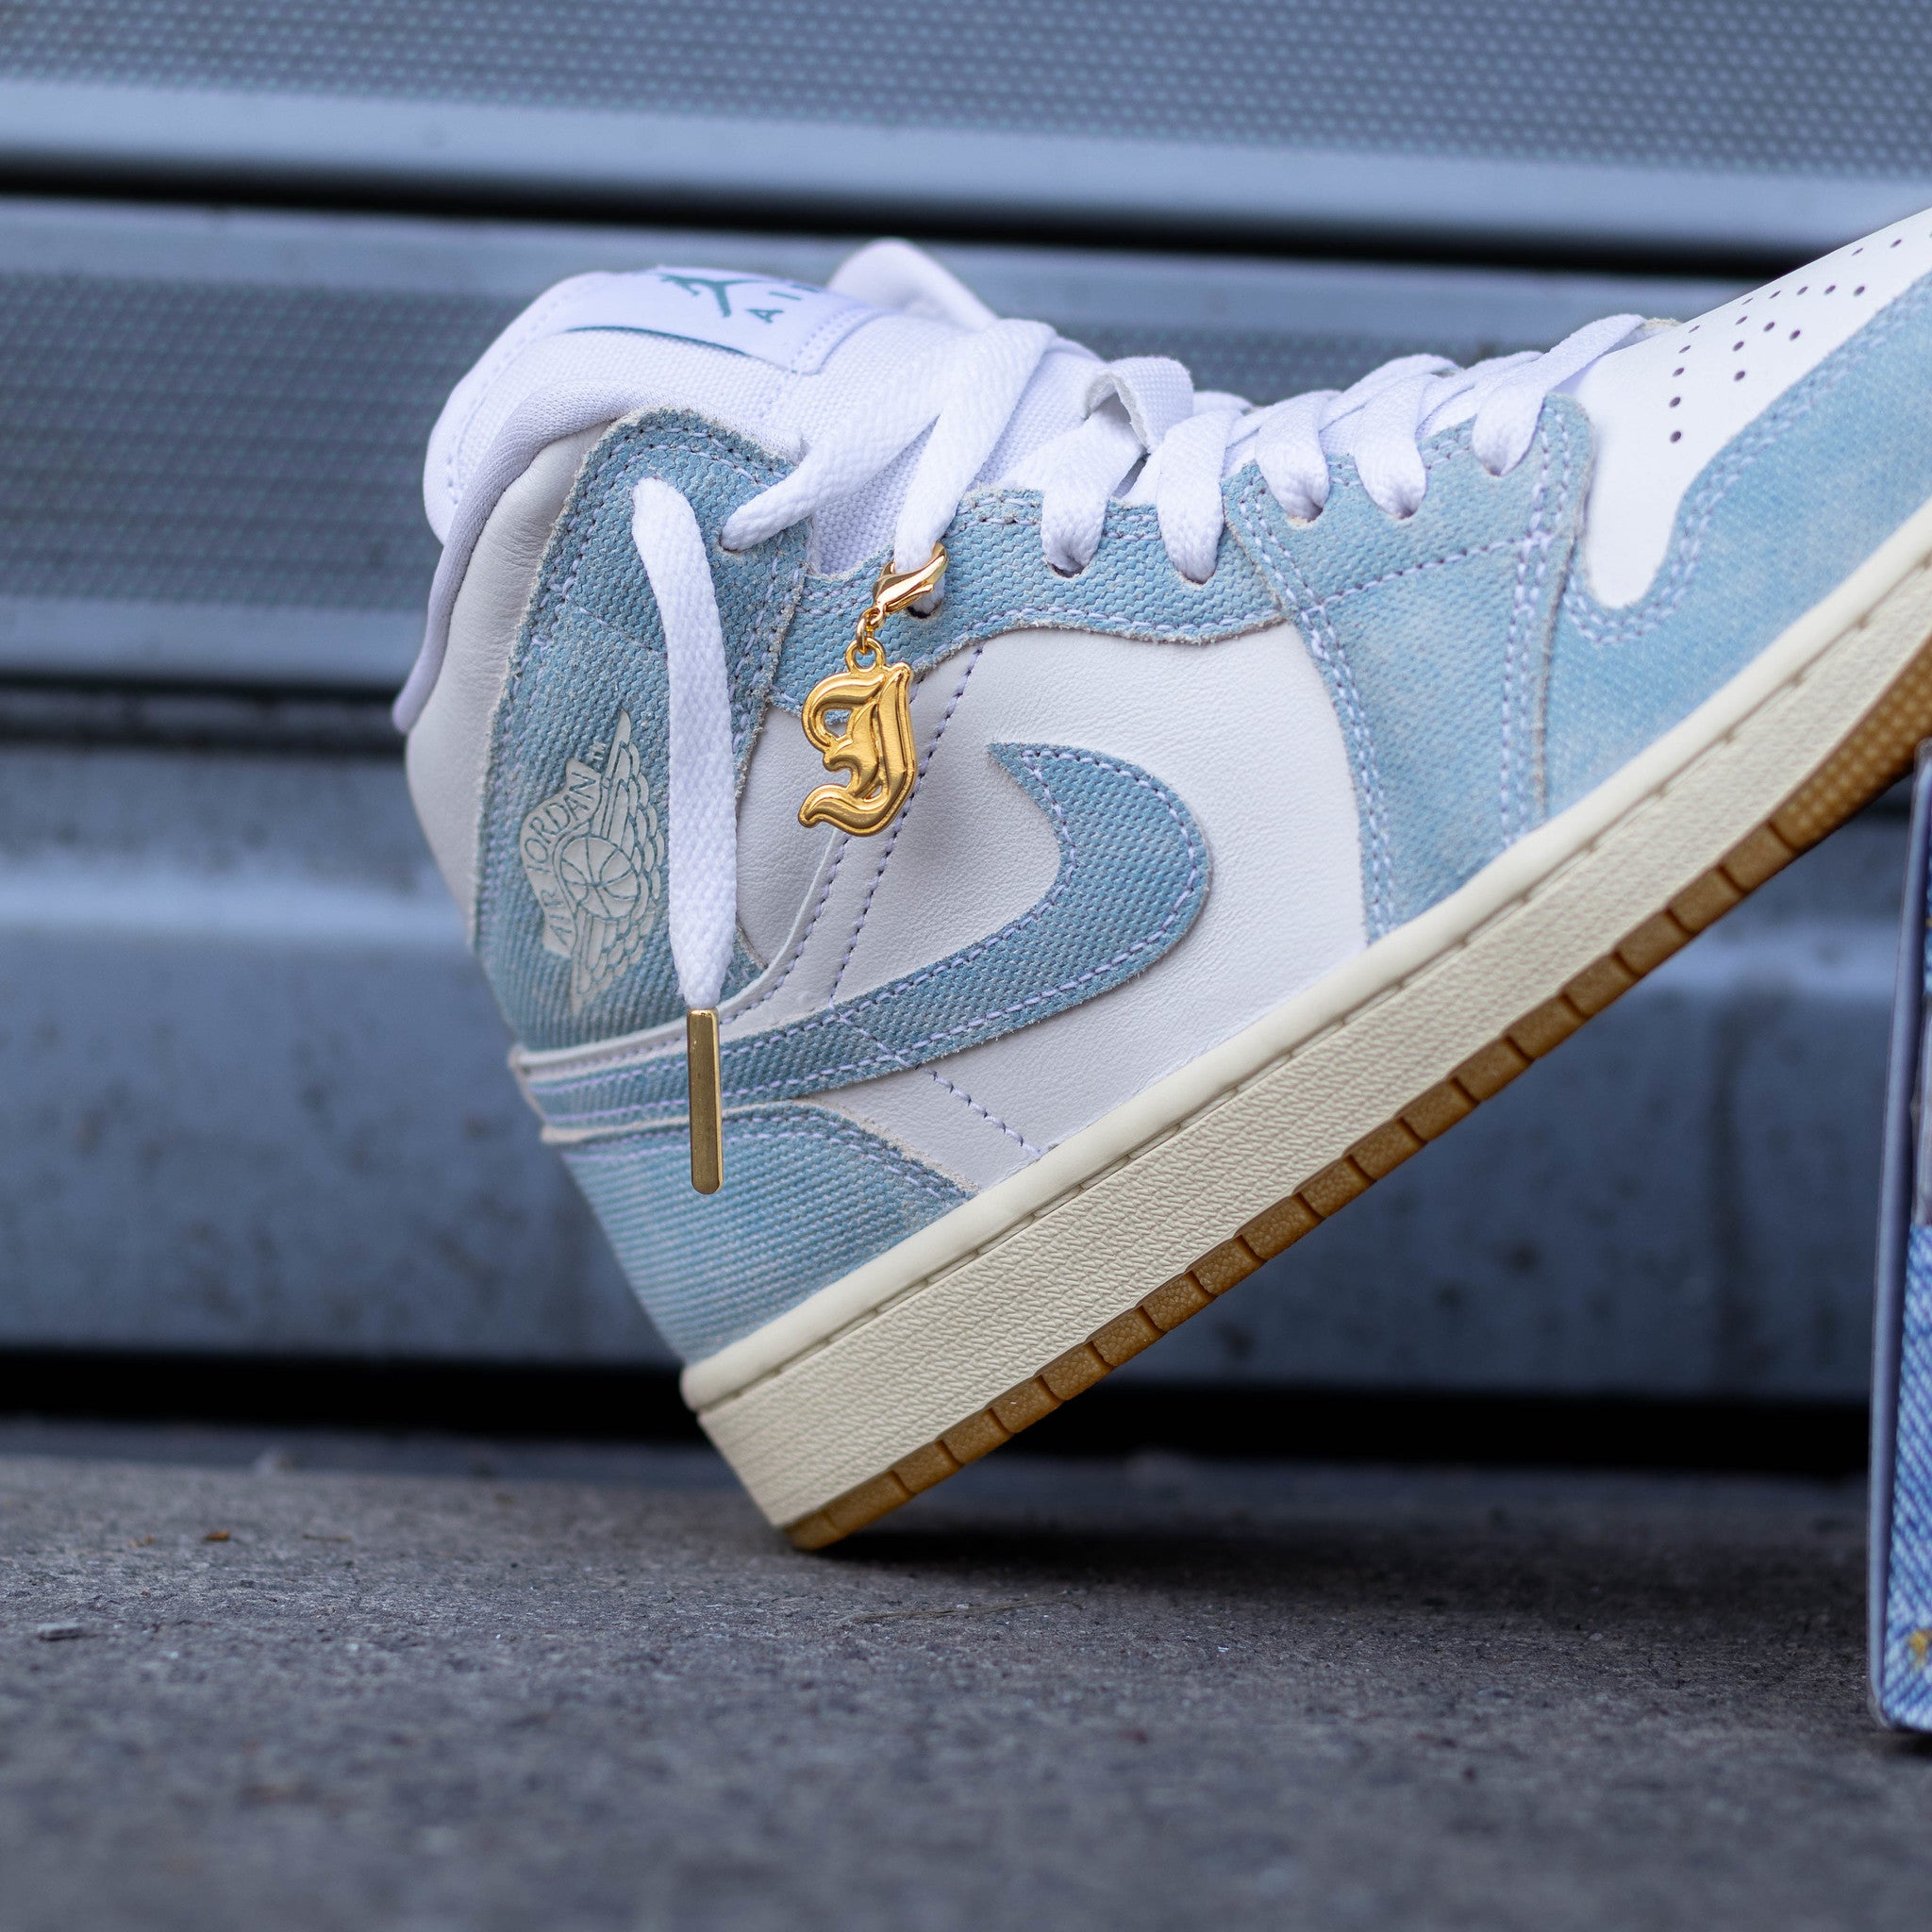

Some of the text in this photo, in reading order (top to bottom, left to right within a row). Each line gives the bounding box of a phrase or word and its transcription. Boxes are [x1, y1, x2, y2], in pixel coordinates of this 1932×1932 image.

[745, 284, 820, 323] AI
[525, 771, 597, 947] AIR JORDAN
